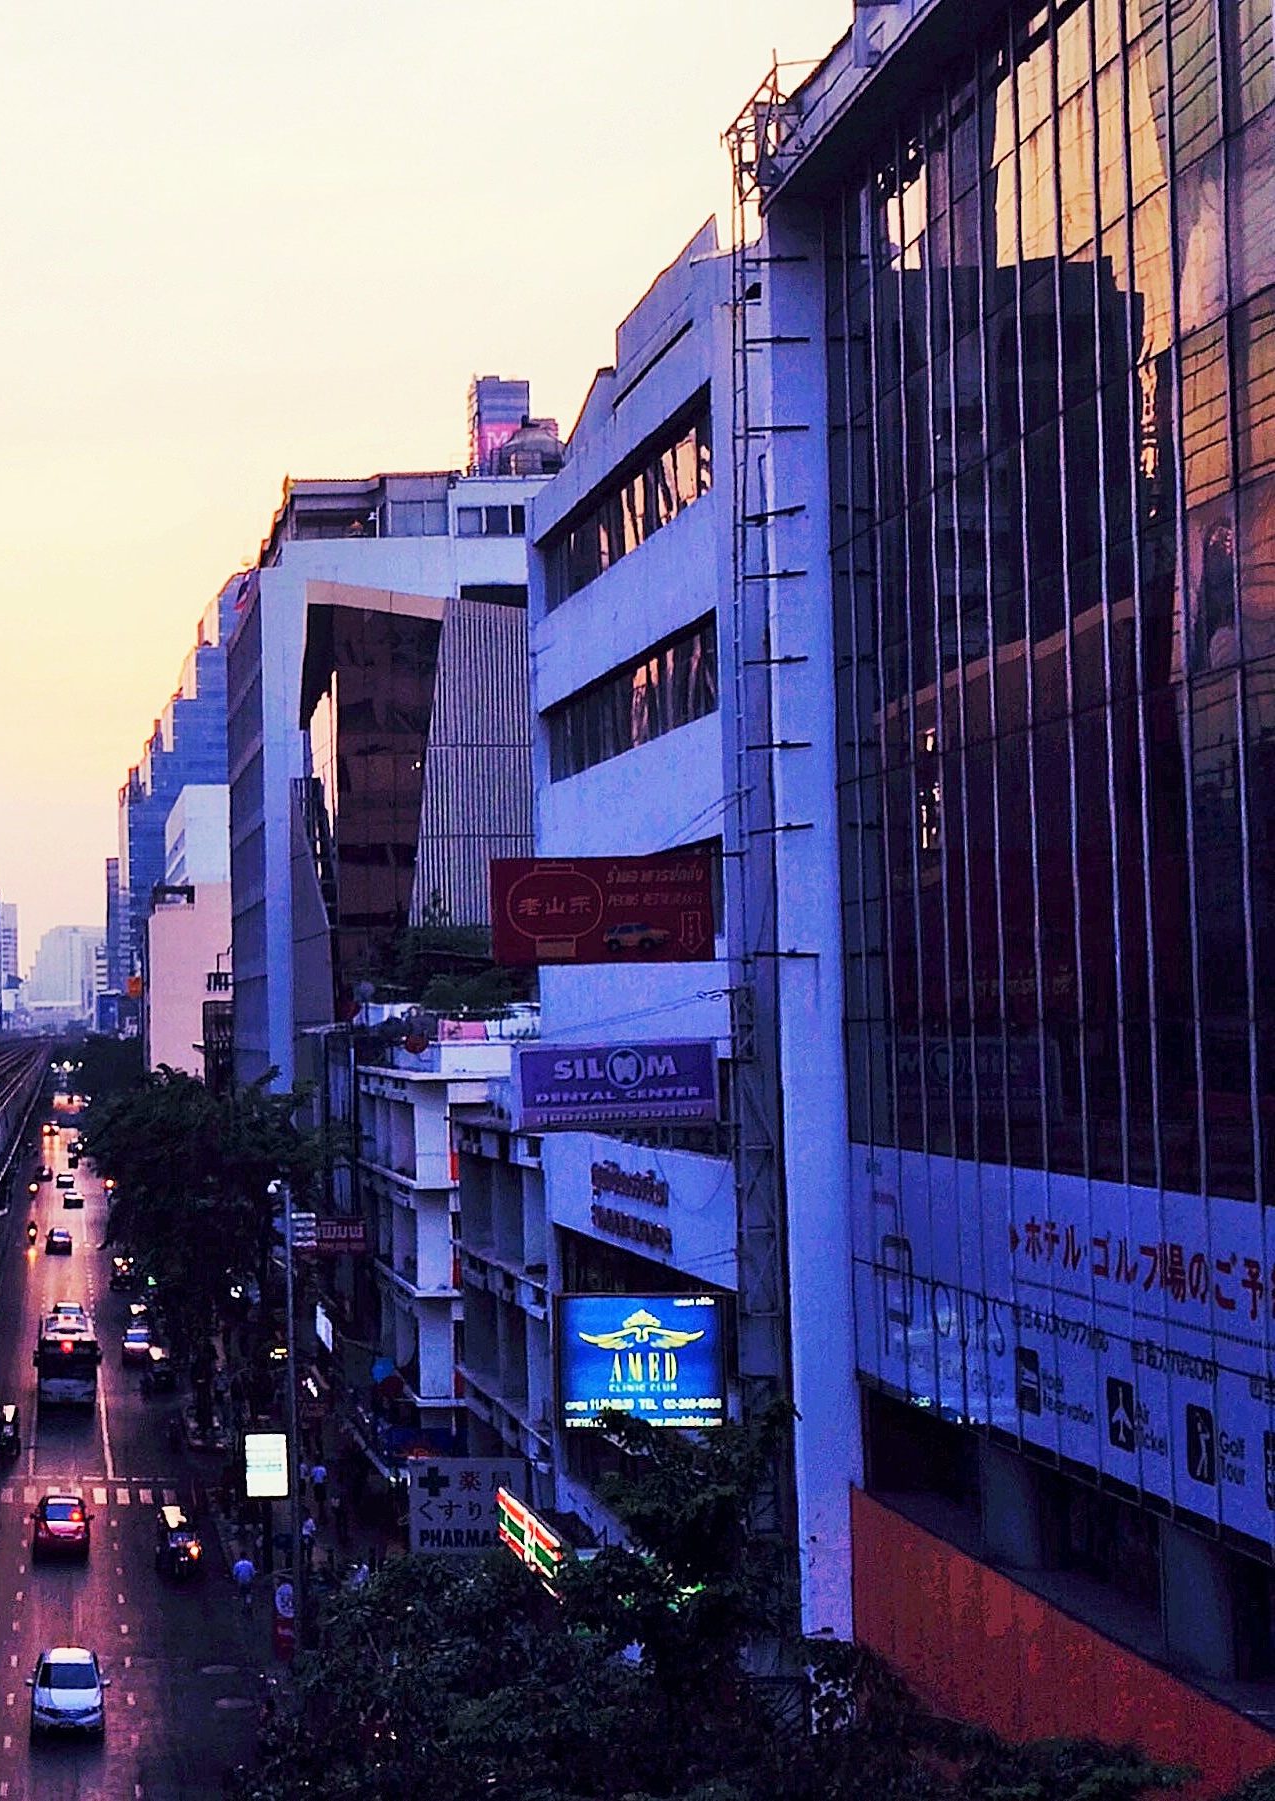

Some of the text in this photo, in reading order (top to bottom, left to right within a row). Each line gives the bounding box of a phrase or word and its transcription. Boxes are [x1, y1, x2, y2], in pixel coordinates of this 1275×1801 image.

[553, 1048, 678, 1089] SILOM
[534, 1086, 701, 1104] DENTAL CENTER
[608, 1382, 646, 1393] CLINIC
[1219, 1430, 1246, 1460] Golf
[419, 1528, 503, 1548] PHARMA
